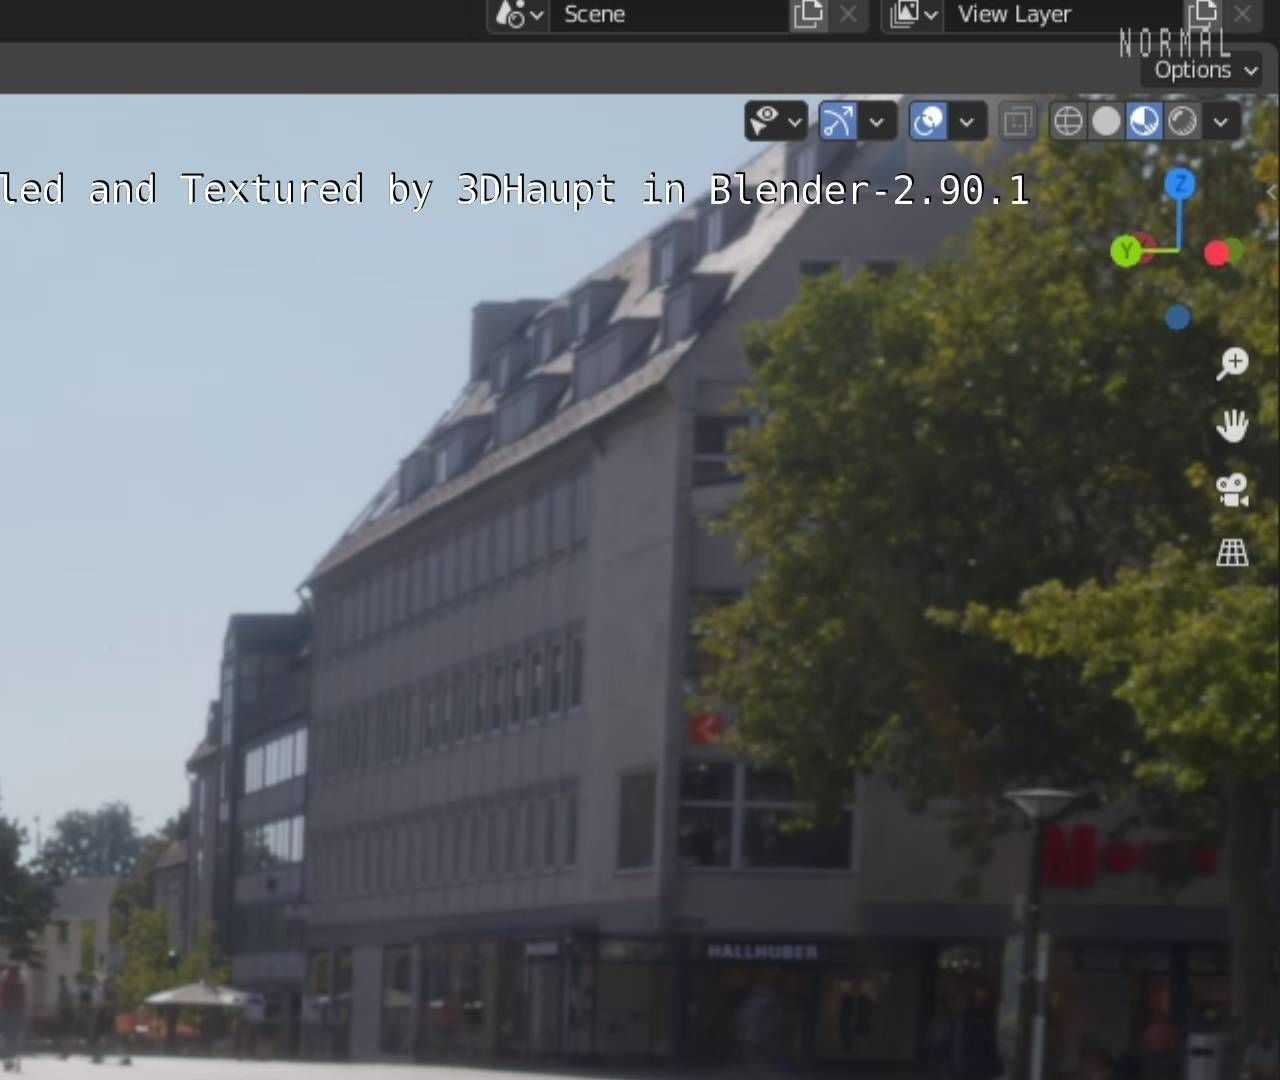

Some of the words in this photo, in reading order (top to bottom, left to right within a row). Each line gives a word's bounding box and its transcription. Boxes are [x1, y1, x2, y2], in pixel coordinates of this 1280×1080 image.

[565, 4, 625, 23] Scene
[958, 4, 1008, 23] View
[1015, 4, 1072, 27] Layer
[1155, 59, 1232, 83] Options
[706, 942, 820, 960] HALLHUBER
